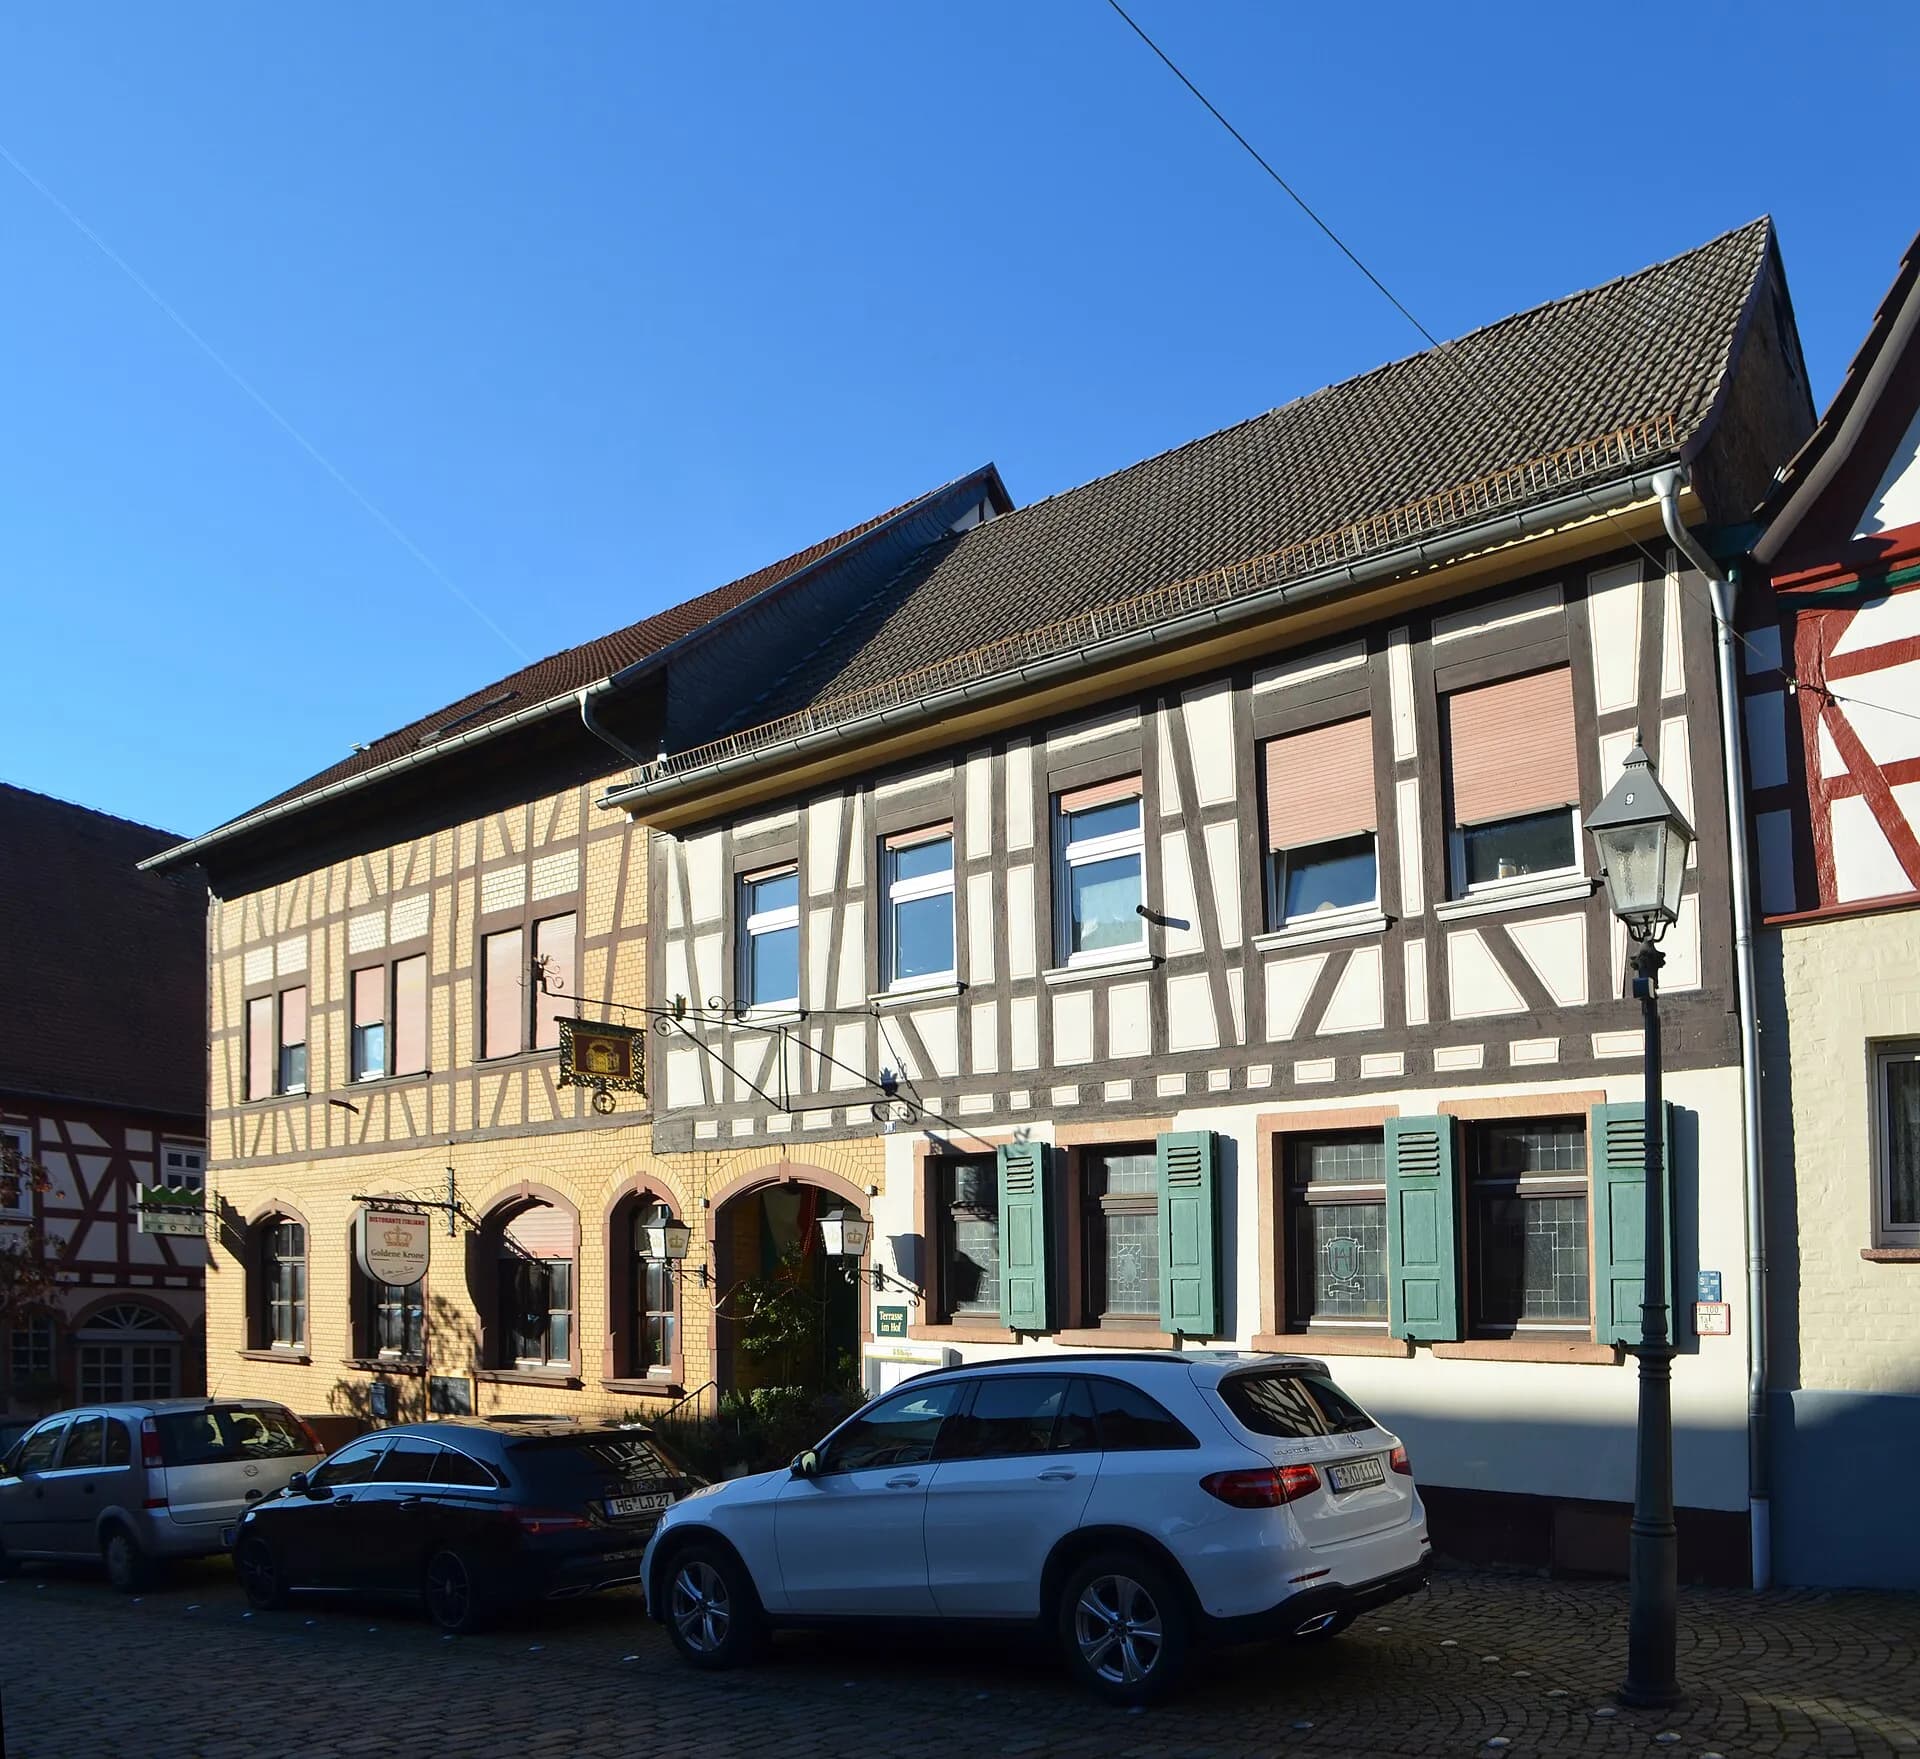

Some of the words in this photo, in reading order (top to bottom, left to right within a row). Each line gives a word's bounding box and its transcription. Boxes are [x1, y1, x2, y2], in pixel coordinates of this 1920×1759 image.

[1625, 793, 1634, 805] 9
[370, 1248, 401, 1257] Goldene
[402, 1250, 425, 1259] Krone
[879, 1310, 904, 1321] Terrasse
[881, 1322, 889, 1332] im
[890, 1322, 902, 1332] Hof
[615, 1499, 634, 1513] HG
[639, 1496, 654, 1509] LD
